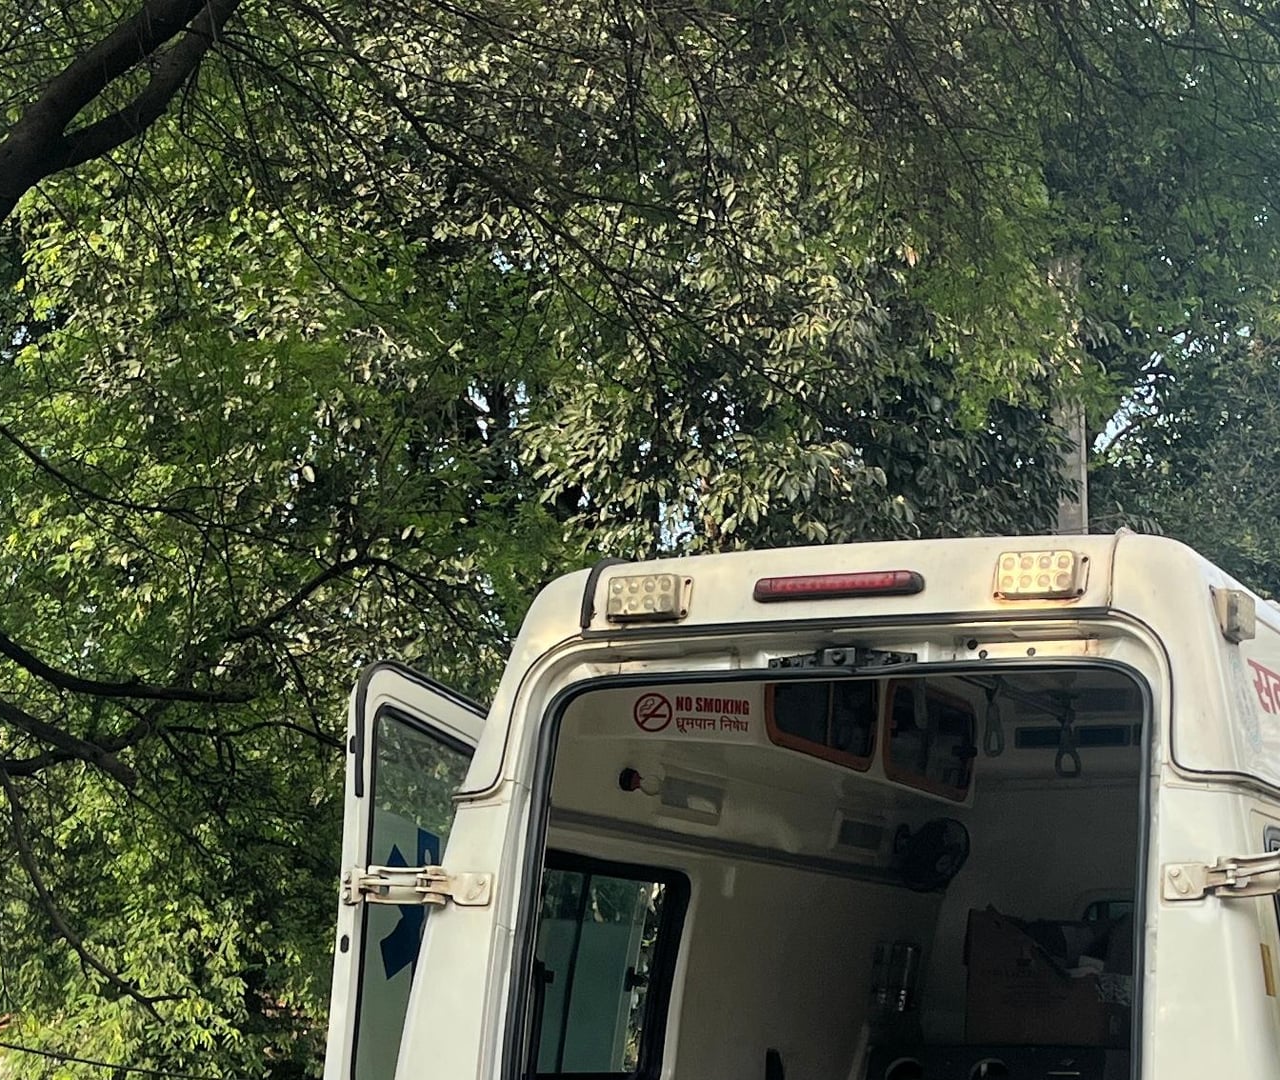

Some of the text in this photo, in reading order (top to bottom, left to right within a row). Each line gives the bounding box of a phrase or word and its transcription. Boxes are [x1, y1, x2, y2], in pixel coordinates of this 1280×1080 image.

[676, 696, 750, 715] NO SMOKING
[676, 715, 748, 734] धूमपान निषेध
